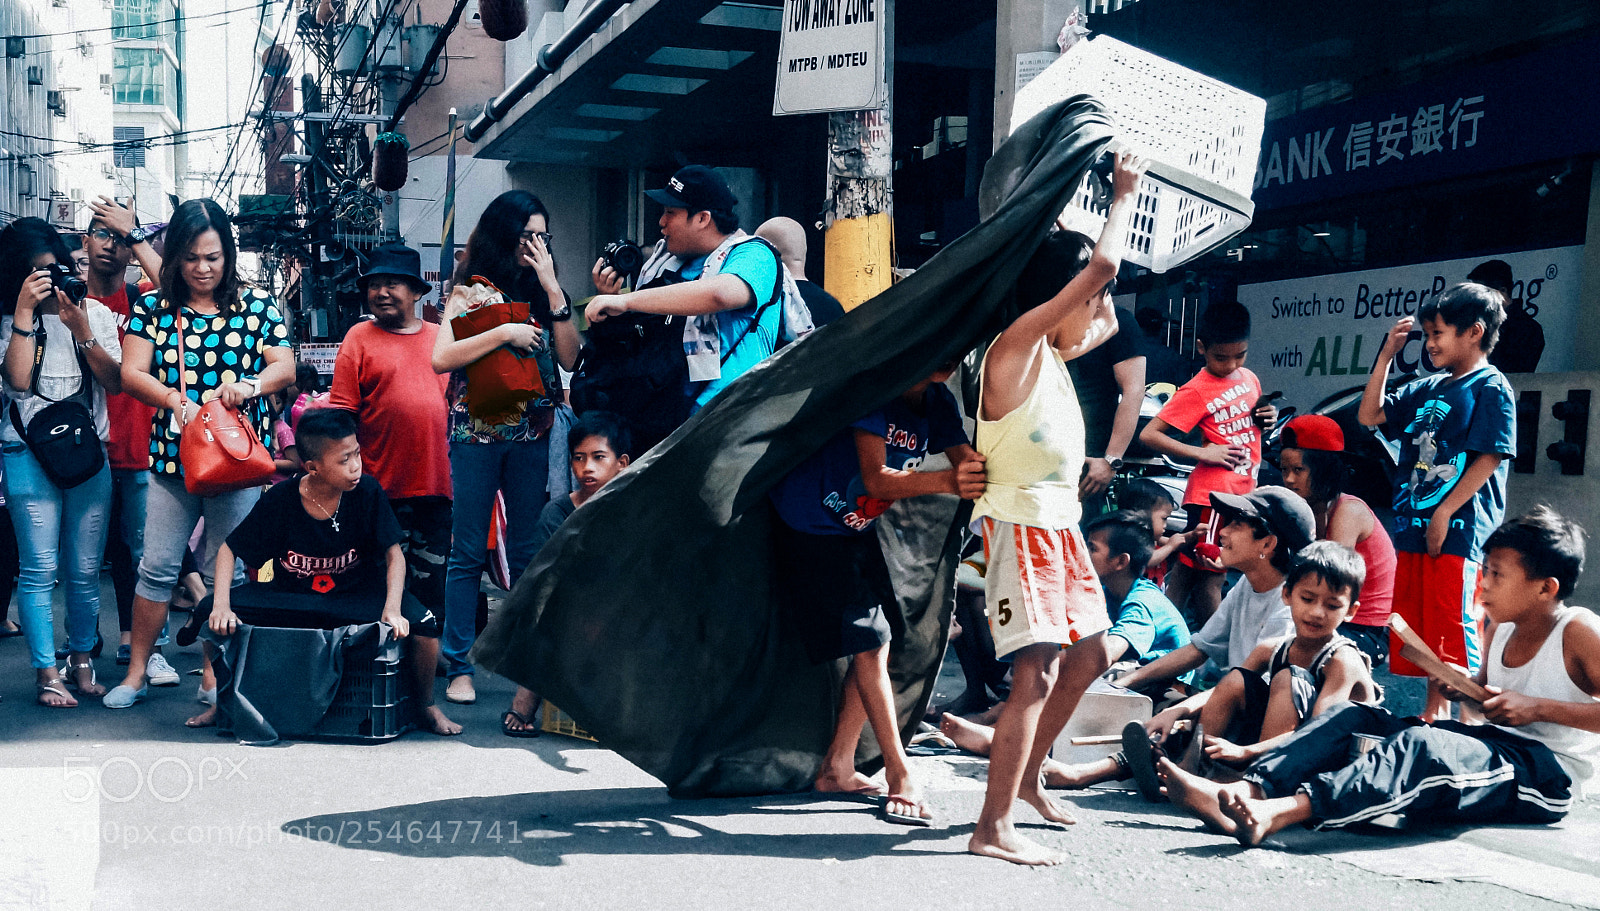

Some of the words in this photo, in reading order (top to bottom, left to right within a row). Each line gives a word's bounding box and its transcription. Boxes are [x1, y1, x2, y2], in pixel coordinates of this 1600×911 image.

[788, 0, 811, 32] TOW
[811, 0, 842, 29] AWAY
[844, 0, 875, 25] ZONE
[788, 56, 818, 73] MTPB
[827, 51, 868, 69] MDTEU
[1342, 94, 1486, 173] 信安銀行
[1271, 293, 1321, 319] Switch
[1327, 296, 1345, 315] to
[1270, 344, 1303, 368] with
[1206, 382, 1251, 414] BAWAL
[1213, 400, 1250, 423] MAG
[997, 597, 1013, 627] 5
